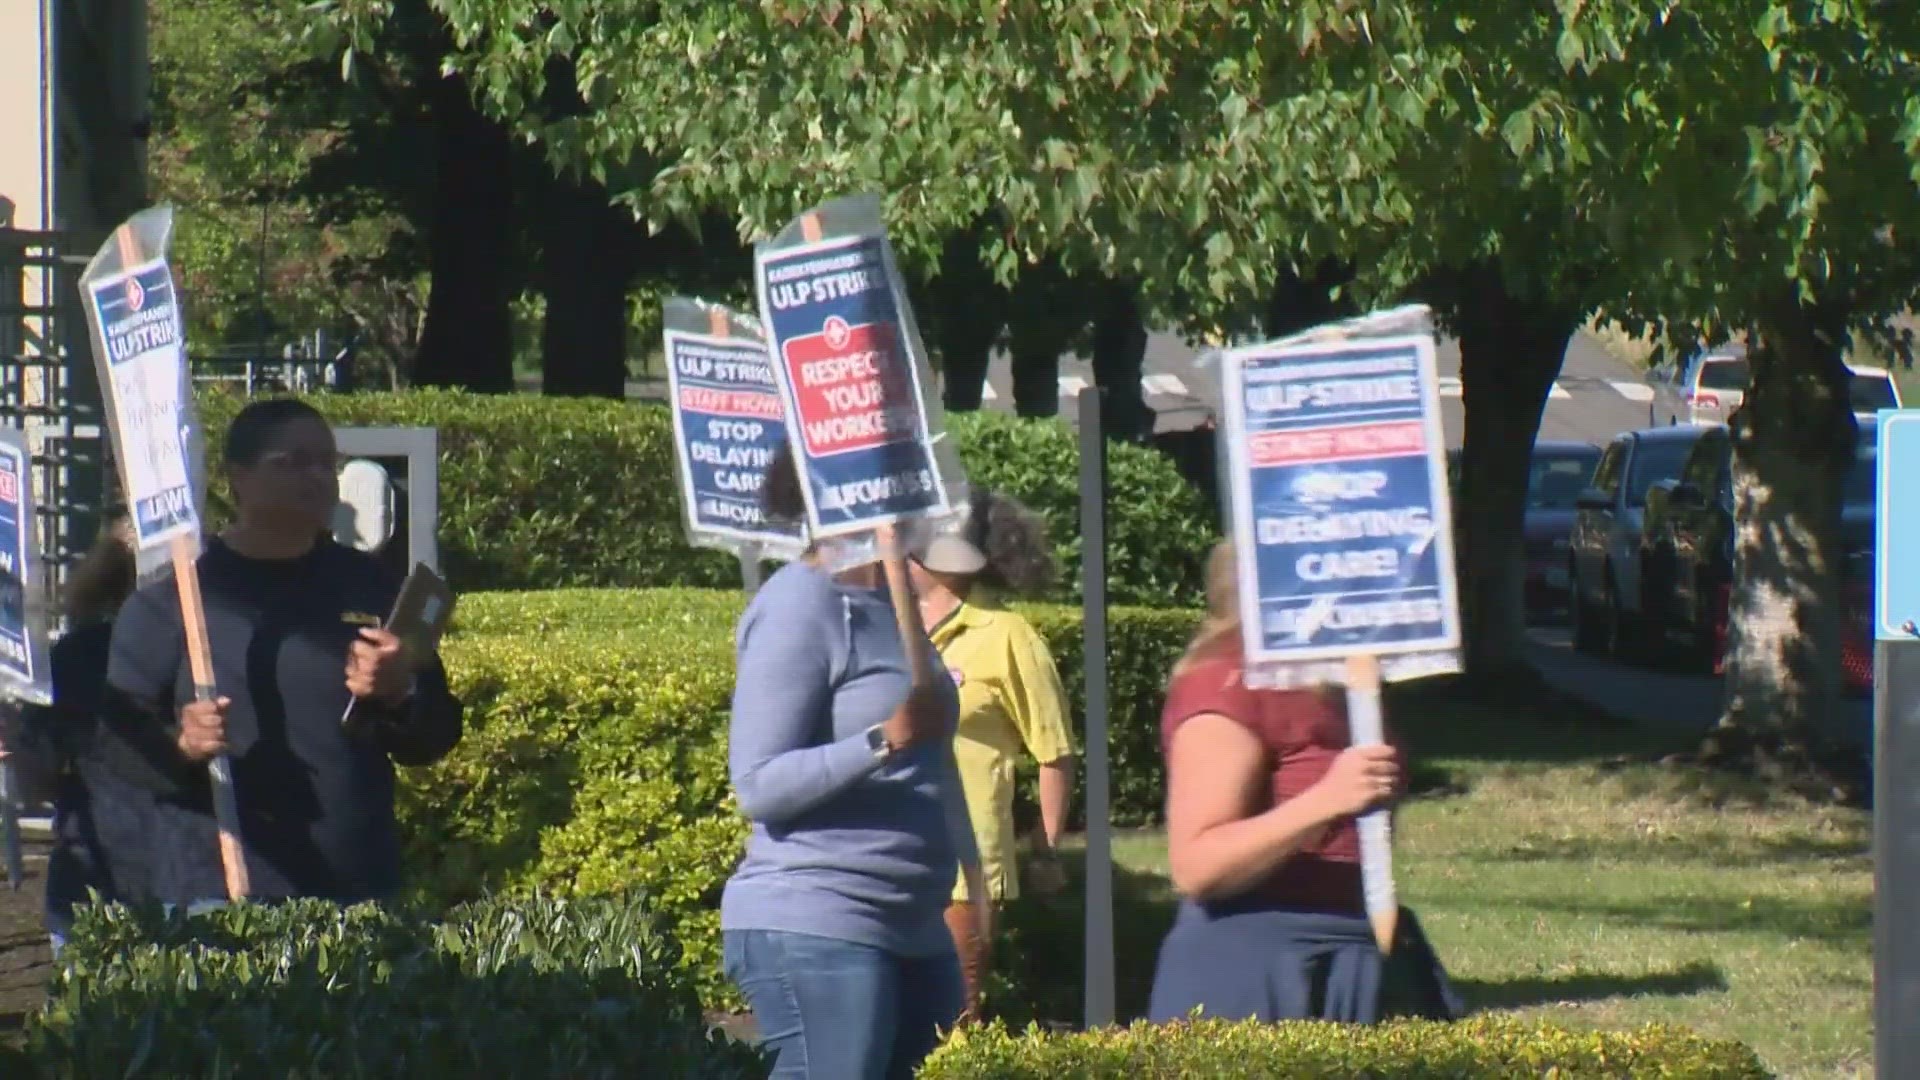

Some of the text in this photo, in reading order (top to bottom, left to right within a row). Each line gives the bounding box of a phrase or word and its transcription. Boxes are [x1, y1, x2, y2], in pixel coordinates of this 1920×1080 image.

[771, 271, 870, 310] ULP STRIK
[678, 356, 714, 378] ULP
[801, 350, 880, 388] RESPEC
[822, 380, 884, 413] YOUR
[708, 420, 764, 442] STOP
[806, 409, 889, 446] WORKE
[691, 441, 777, 467] DELAYIN
